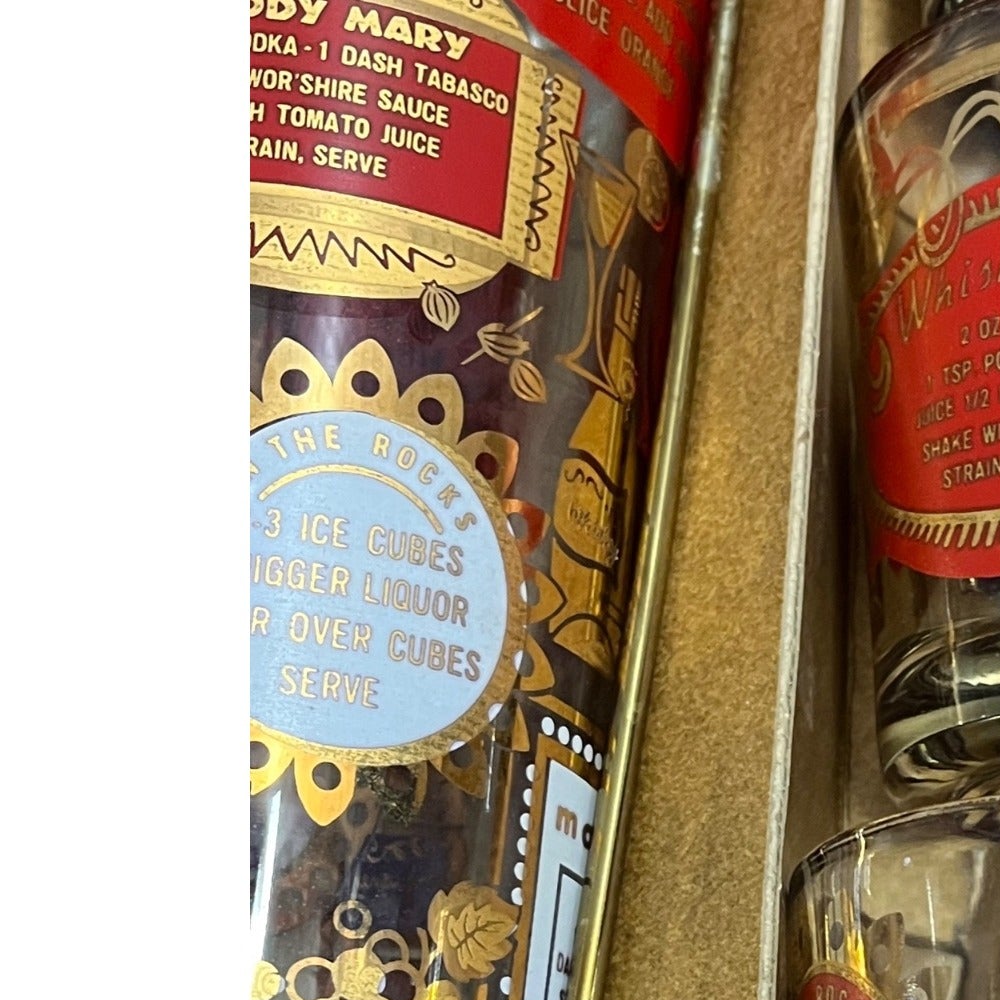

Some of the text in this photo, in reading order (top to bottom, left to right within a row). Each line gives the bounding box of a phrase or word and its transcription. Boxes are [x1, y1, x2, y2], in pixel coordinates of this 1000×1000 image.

[344, 6, 471, 61] MARY
[557, 0, 611, 35] LICE
[250, 33, 298, 57] DKA
[319, 40, 329, 61] 1
[341, 45, 402, 79] DASH
[414, 62, 509, 115] TABASCO
[276, 104, 371, 140] TOMATO
[380, 124, 440, 158] JUICE
[377, 88, 449, 127] SAUCE
[312, 144, 387, 178] SERVE
[960, 326, 971, 345] 2
[964, 389, 990, 411] 1/2
[922, 429, 973, 463] SHAKE
[267, 424, 478, 532] THE ROCKS
[300, 512, 350, 549] ICE
[366, 524, 465, 577] CUBES
[363, 572, 470, 628] LIQUOR
[288, 610, 372, 653] OVER
[388, 629, 483, 682] CUBES
[279, 664, 380, 709] SERVE
